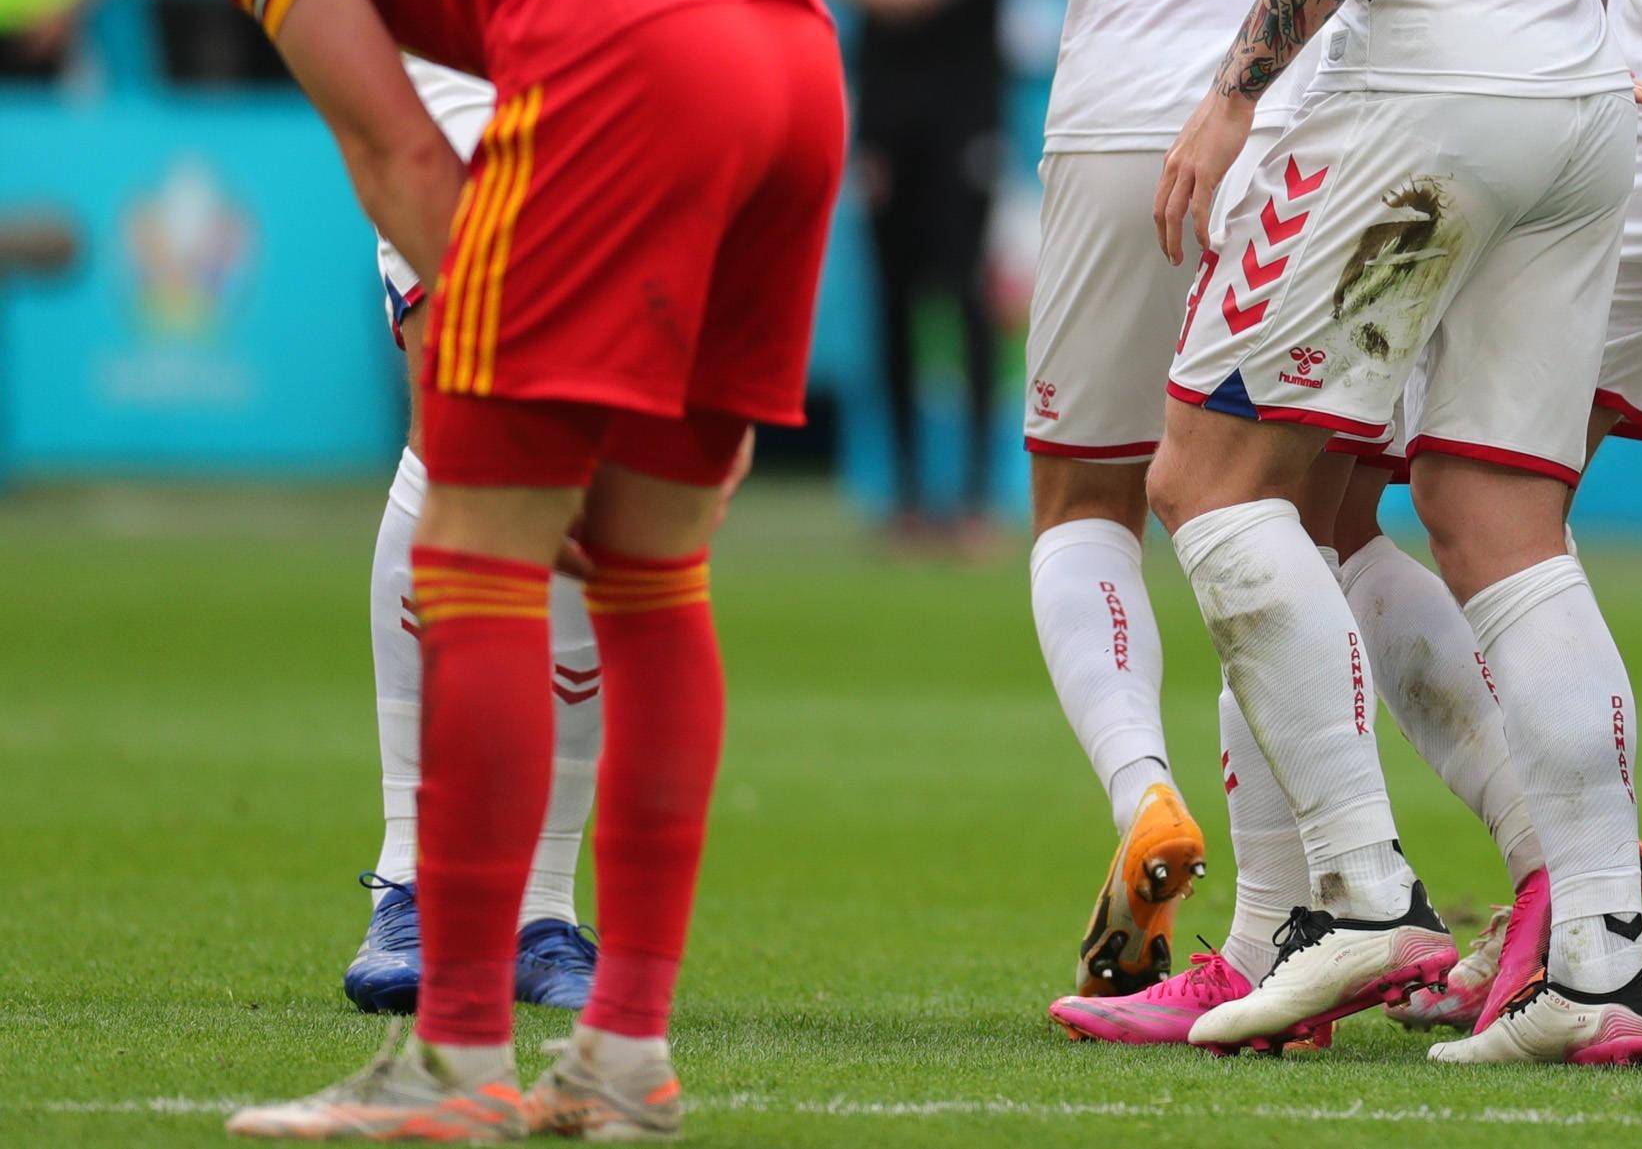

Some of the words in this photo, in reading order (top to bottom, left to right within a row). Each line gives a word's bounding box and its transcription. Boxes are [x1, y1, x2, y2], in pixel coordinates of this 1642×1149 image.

[1279, 371, 1324, 389] hummel
[1100, 581, 1131, 672] DANMARK
[1349, 632, 1369, 736] DANMARK
[1549, 994, 1570, 1011] COPA
